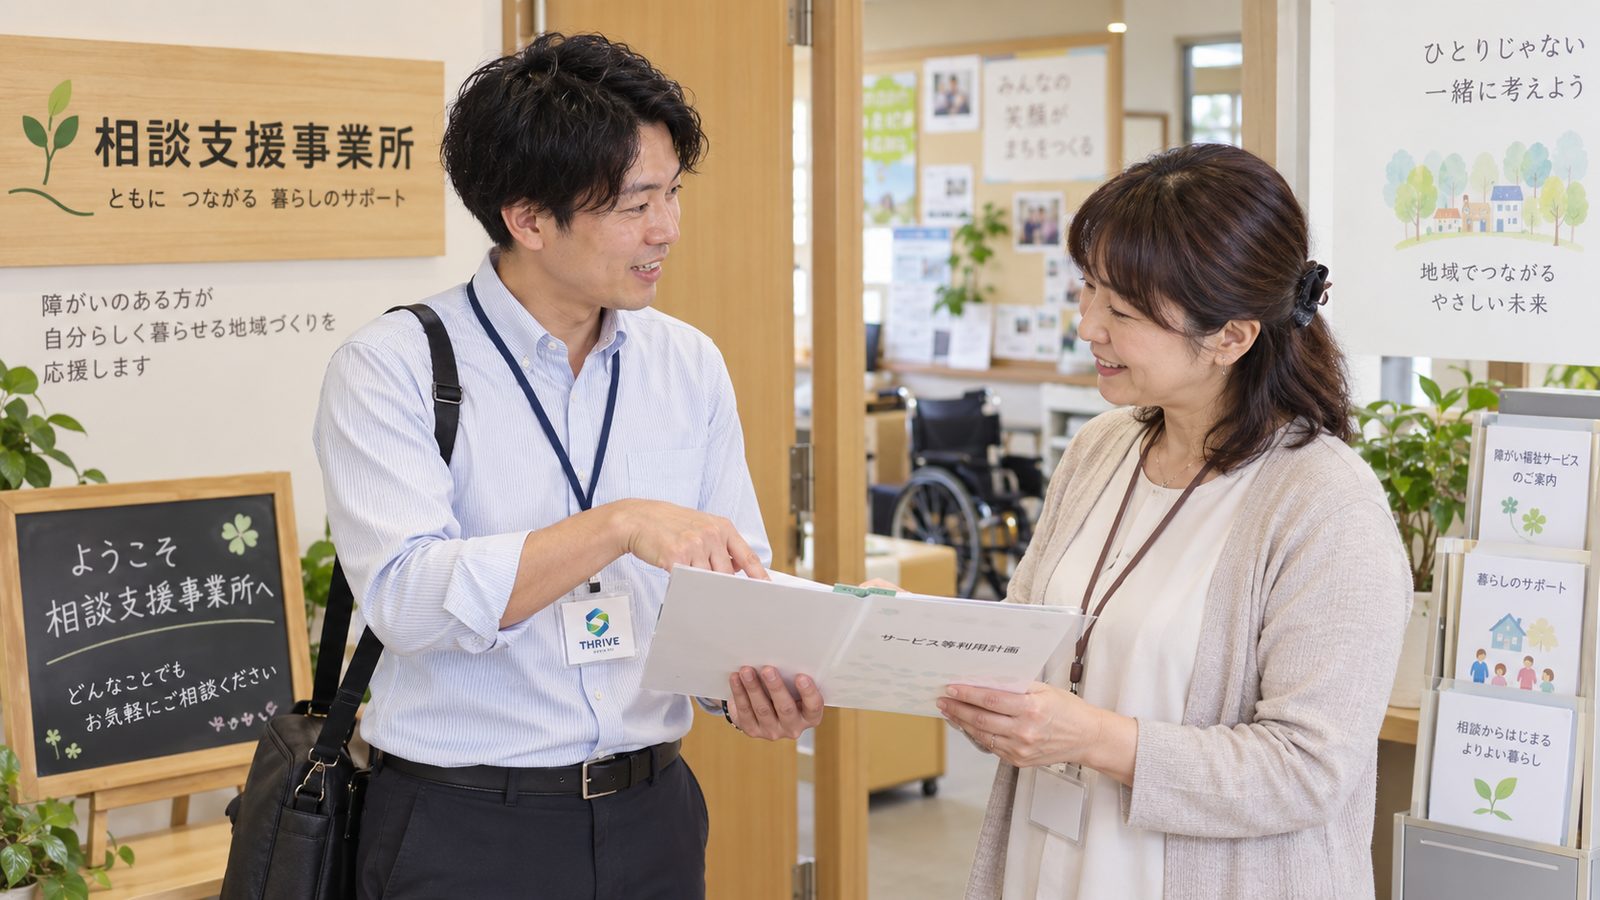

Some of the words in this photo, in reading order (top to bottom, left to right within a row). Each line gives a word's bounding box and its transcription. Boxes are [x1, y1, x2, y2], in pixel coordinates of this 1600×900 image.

[1424, 34, 1586, 64] ひとりじゃない
[998, 74, 1071, 96] みんなの
[1425, 74, 1584, 104] 一緒に考えよう
[95, 116, 415, 170] 相談支援事業所
[1004, 136, 1094, 160] まちをつくる
[108, 188, 166, 208] ともに
[182, 188, 257, 209] つながる
[270, 188, 406, 209] 暮らしのサポート
[1420, 262, 1556, 283] 地域でつながる
[41, 287, 213, 317] 障がいのある方が
[1431, 293, 1549, 314] やさしい未来
[44, 312, 337, 351] 自分らしく暮らせる地域づくりを
[42, 355, 152, 385] 応援します
[1494, 449, 1579, 467] 障がい福祉サービス
[1512, 472, 1557, 487] のご案内
[72, 536, 178, 577] ようこそ
[1477, 572, 1567, 595] 暮らしのサポート
[45, 573, 275, 639] 相談支援事業所へ
[579, 636, 620, 650] THRIVE
[880, 634, 1020, 655] サービス等利用計画
[67, 661, 186, 706] どんなことでも
[85, 665, 278, 732] お気軽にご相談ください
[1456, 720, 1551, 747] 相談からはじまる
[1461, 742, 1542, 767] よりよい暮らし
